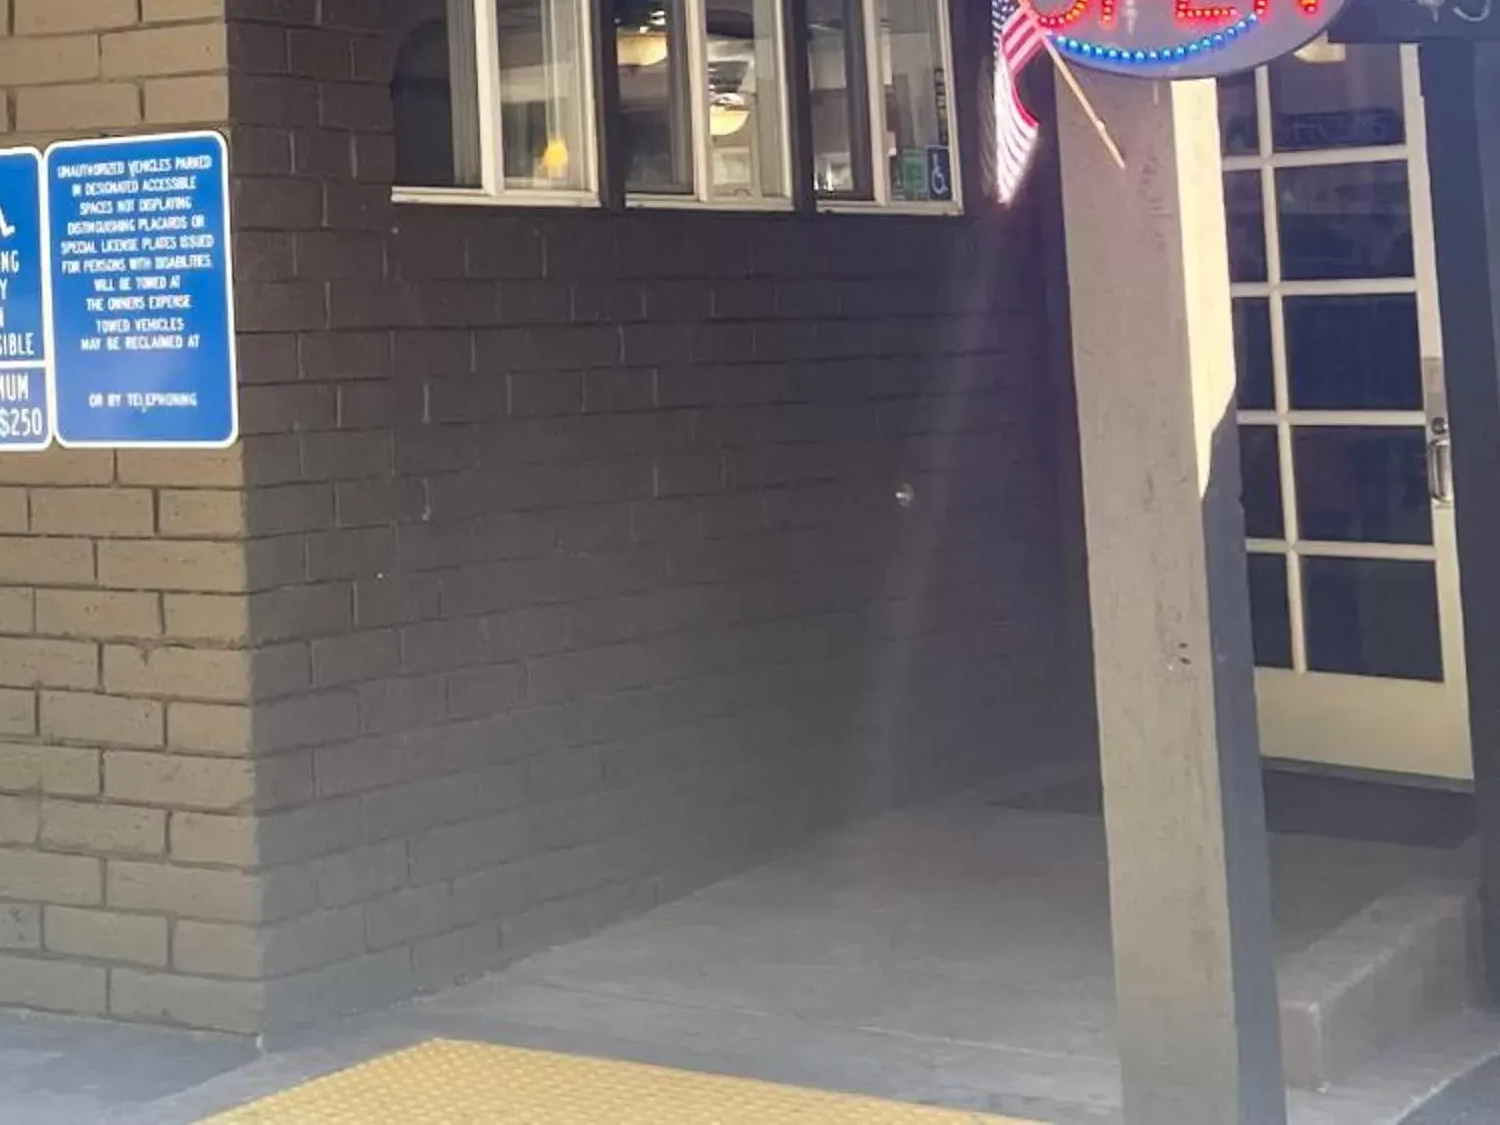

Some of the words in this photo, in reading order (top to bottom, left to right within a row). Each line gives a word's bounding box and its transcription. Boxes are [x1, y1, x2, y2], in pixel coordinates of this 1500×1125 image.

[128, 157, 172, 175] VEHICLES
[175, 154, 213, 171] PARKED
[85, 179, 139, 196] DESIGNATED
[143, 175, 197, 192] ACCESSIBLE
[79, 199, 113, 216] SPACES
[117, 199, 135, 213] NOT
[139, 196, 192, 212] DISPLAYING
[138, 217, 187, 232] PLACARDS
[192, 215, 205, 229] OR
[60, 241, 98, 255] SPECIAL
[101, 238, 139, 253] LICENSE
[142, 236, 177, 250] PLATES
[180, 234, 215, 249] ISSUED
[62, 260, 80, 274] FOR
[83, 258, 126, 273] PERSONS
[129, 257, 152, 271] WITH
[94, 278, 115, 292] WILL
[119, 276, 132, 290] BE
[135, 276, 167, 290] TOWED
[170, 274, 181, 289] AT
[86, 297, 104, 311] THE
[149, 294, 191, 308] EXPENSE
[96, 319, 130, 334] TOWED
[134, 316, 185, 332] VEHICLES
[81, 337, 101, 351] MAY
[107, 335, 120, 351] BE
[125, 335, 183, 350] RECLAIMED
[187, 334, 200, 348] AT
[89, 393, 103, 408] OR
[108, 392, 121, 407] BY
[127, 391, 197, 408] TELEPHONING
